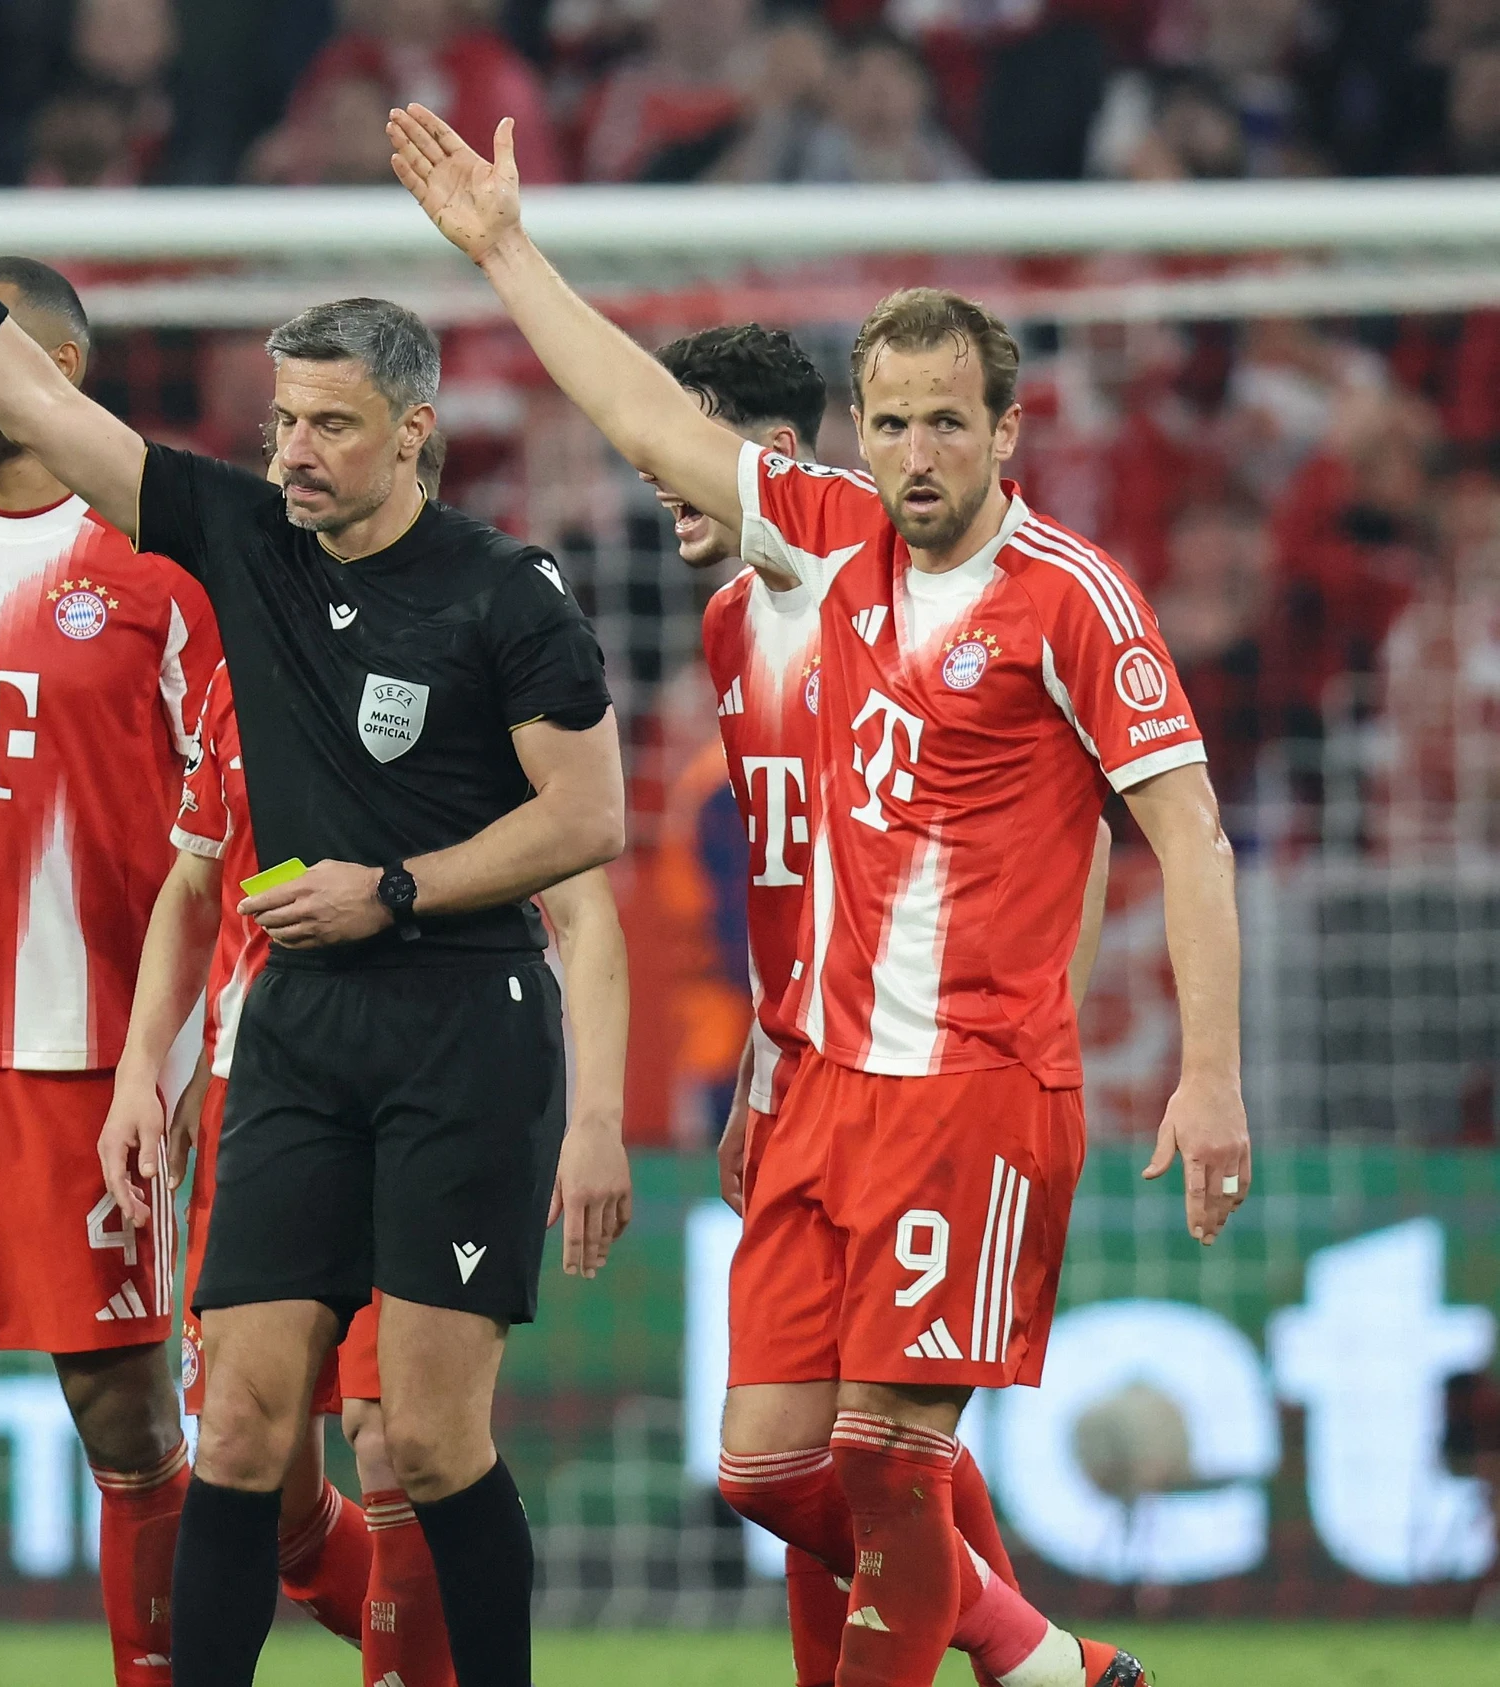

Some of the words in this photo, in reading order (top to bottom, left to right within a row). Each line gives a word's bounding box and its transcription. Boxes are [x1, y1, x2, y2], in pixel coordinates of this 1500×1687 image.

[72, 595, 102, 615] BAYERN
[375, 687, 412, 706] UEFA
[370, 711, 411, 727] MATCH
[363, 723, 412, 741] OFFICIAL
[1127, 714, 1190, 747] Allianz
[86, 1171, 138, 1266] 4
[894, 1209, 950, 1307] 9
